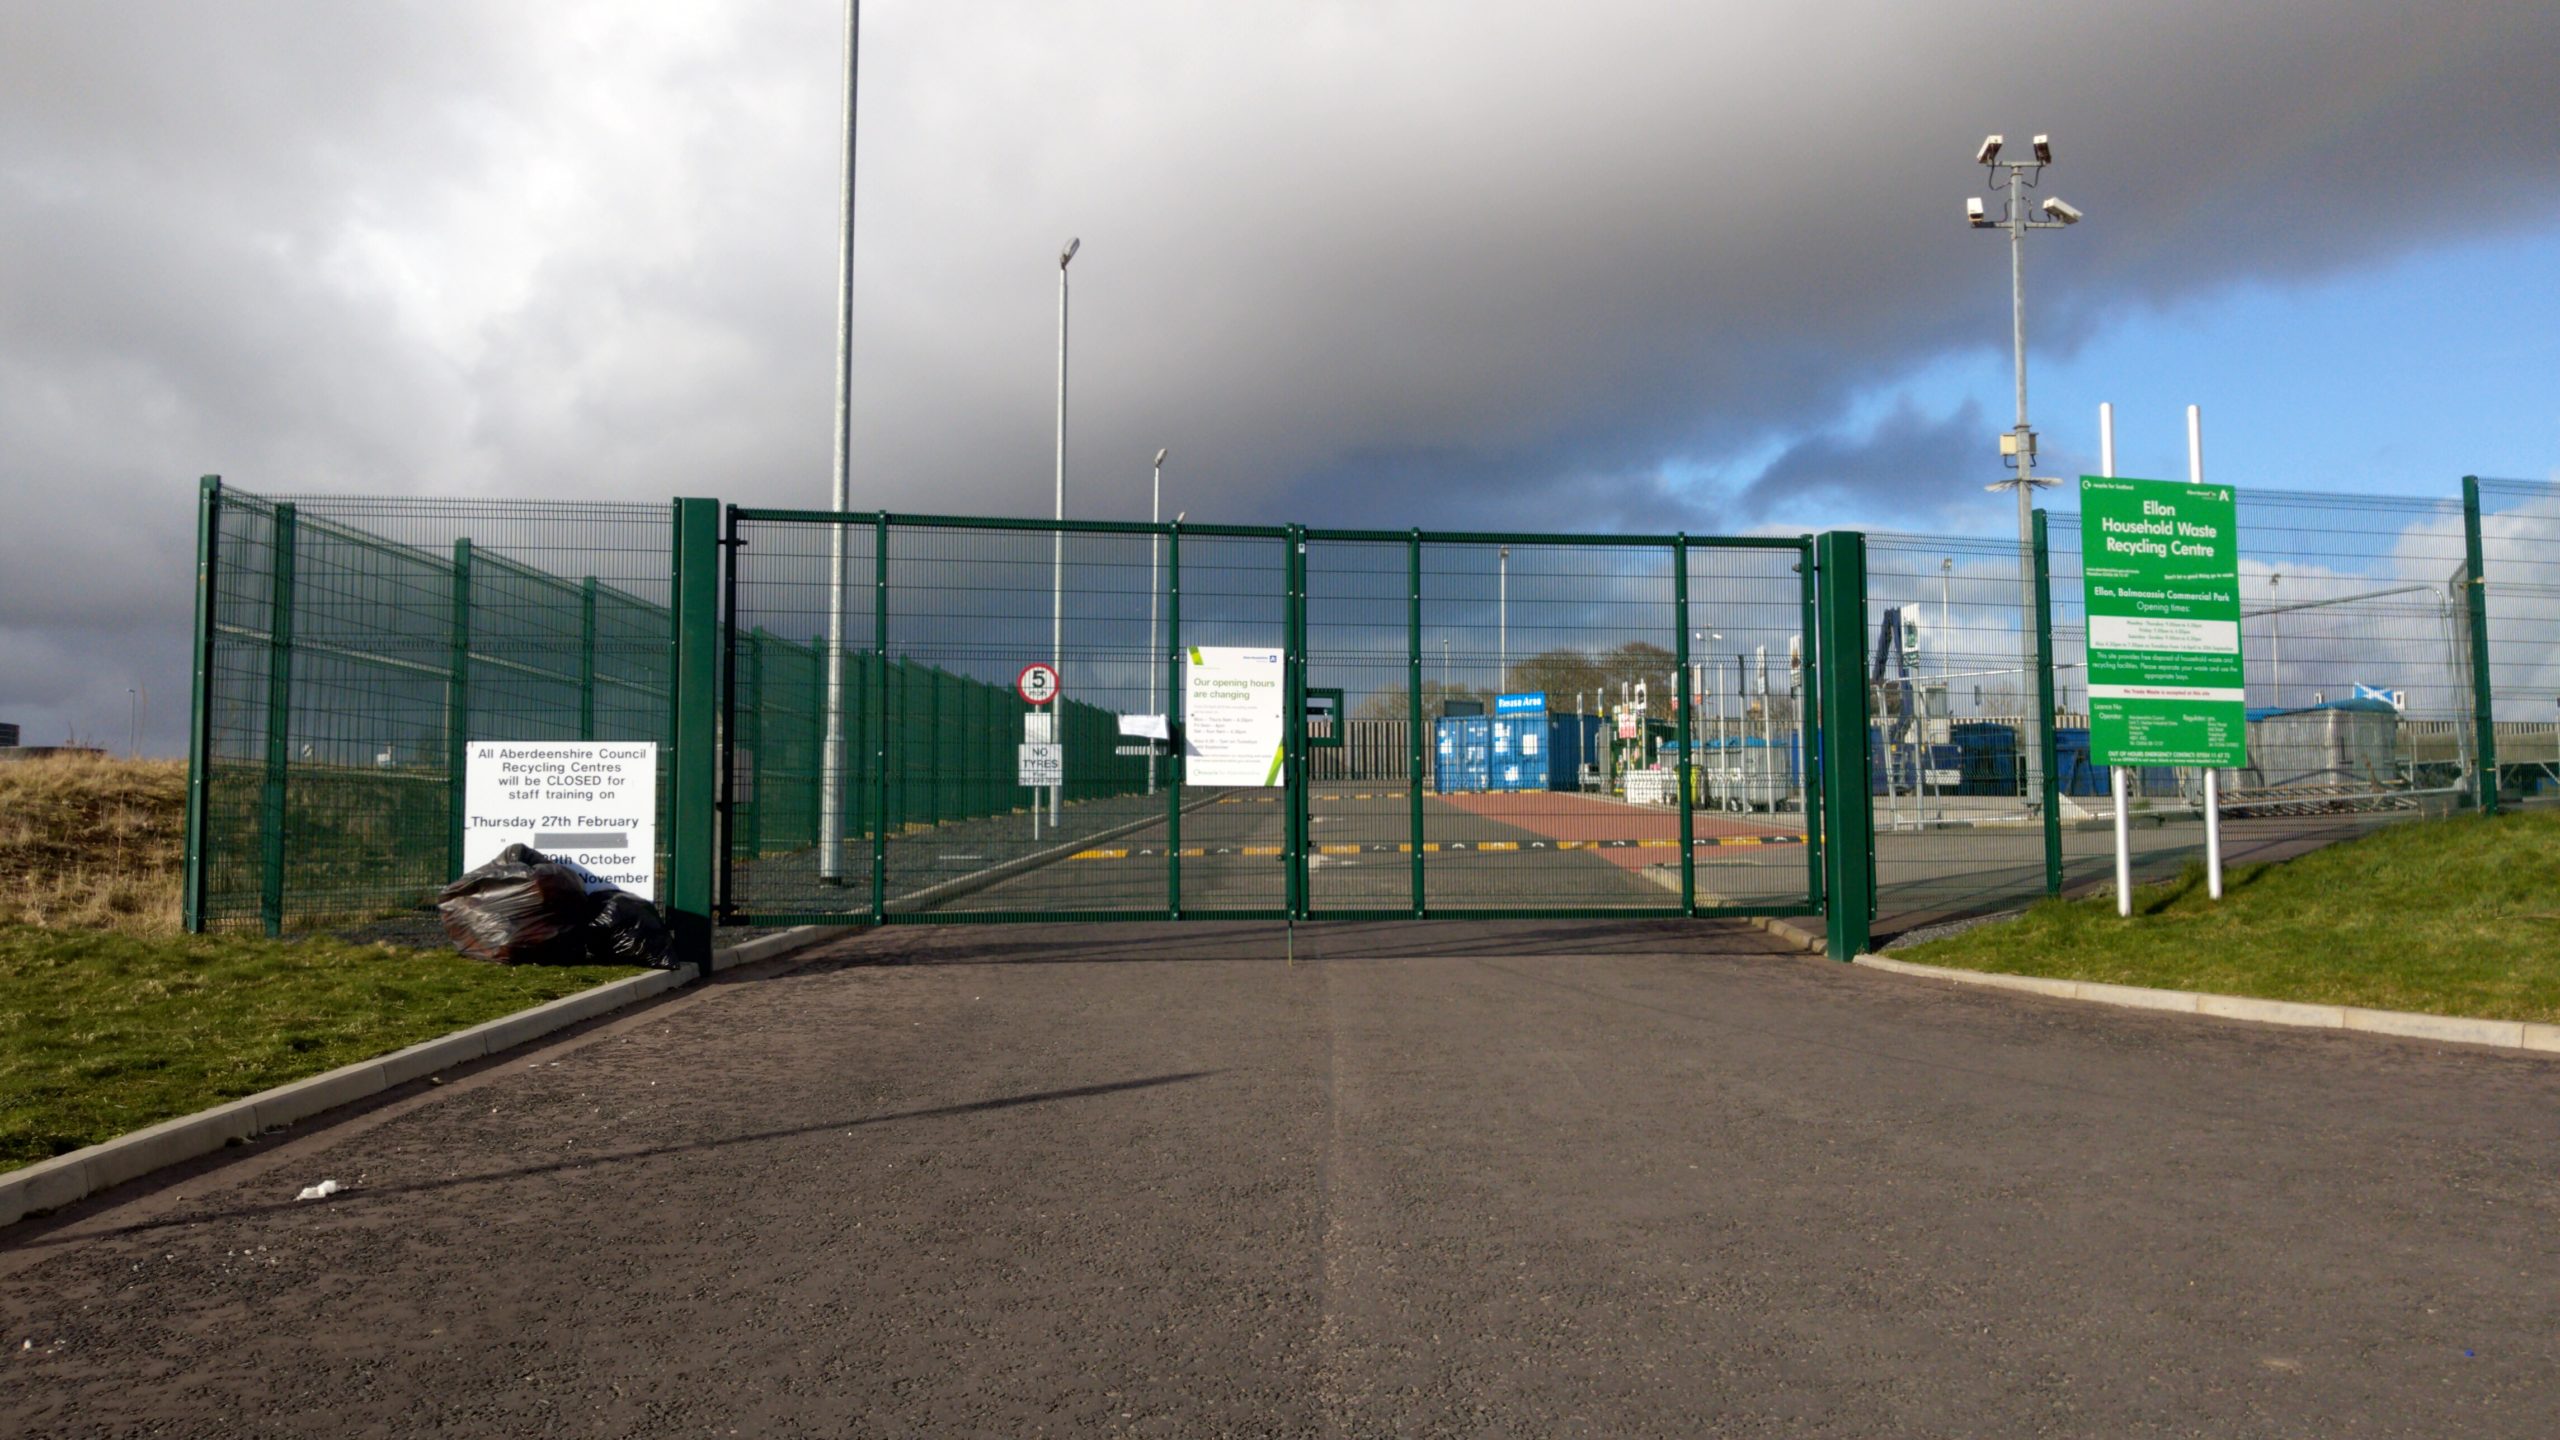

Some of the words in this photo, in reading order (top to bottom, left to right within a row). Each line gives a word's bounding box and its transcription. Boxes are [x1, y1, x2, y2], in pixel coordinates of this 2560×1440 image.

[2143, 500, 2176, 516] Ellon
[2102, 517, 2174, 536] Household
[2177, 522, 2216, 538] Waste
[2106, 537, 2167, 558] Recycling
[2171, 540, 2214, 557] Centre
[2094, 586, 2116, 597] Ellon,
[2166, 590, 2212, 600] Commercial
[2214, 592, 2230, 602] Park
[2136, 600, 2169, 614] Opening
[1032, 670, 1045, 688] 5
[1194, 678, 1210, 686] Our
[1212, 678, 1248, 688] opening
[1250, 679, 1275, 688] hours
[1209, 690, 1250, 700] changing
[1522, 696, 1542, 706] Area
[478, 748, 494, 758] All
[500, 748, 593, 759] Aberdeenshire
[599, 748, 646, 759] Council
[1032, 748, 1048, 756] NO
[502, 762, 565, 774] Recycling
[571, 762, 622, 772] Centres
[1023, 760, 1058, 768] TYRES
[498, 776, 518, 786] will
[525, 776, 541, 786] be
[547, 776, 601, 786] CLOSED
[608, 776, 626, 786] for
[509, 789, 540, 800] staff
[546, 790, 593, 801] training
[599, 791, 615, 800] on
[472, 816, 536, 828] Thursday
[541, 816, 572, 827] 27th
[578, 816, 639, 828] February
[579, 854, 636, 865] October
[579, 873, 648, 884] November
